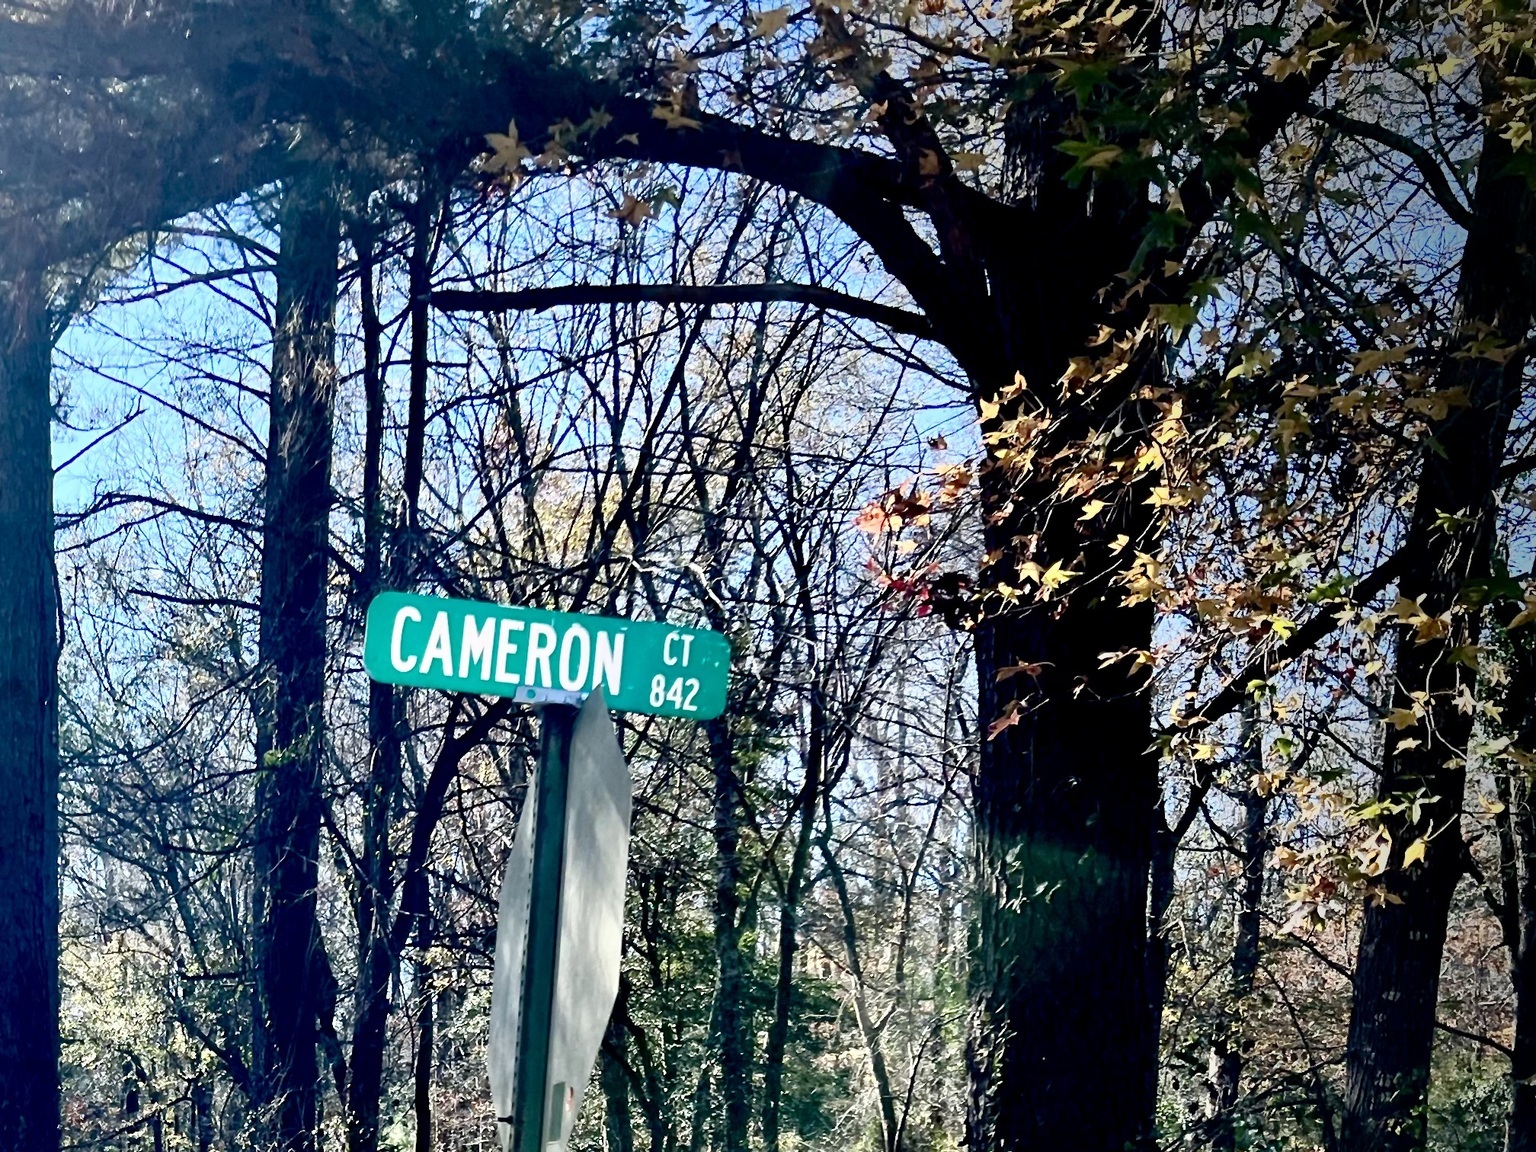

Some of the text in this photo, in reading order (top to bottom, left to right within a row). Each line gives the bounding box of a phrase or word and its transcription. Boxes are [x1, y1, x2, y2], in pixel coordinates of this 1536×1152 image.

[390, 605, 695, 696] CAMERON CT
[649, 673, 701, 712] 842
